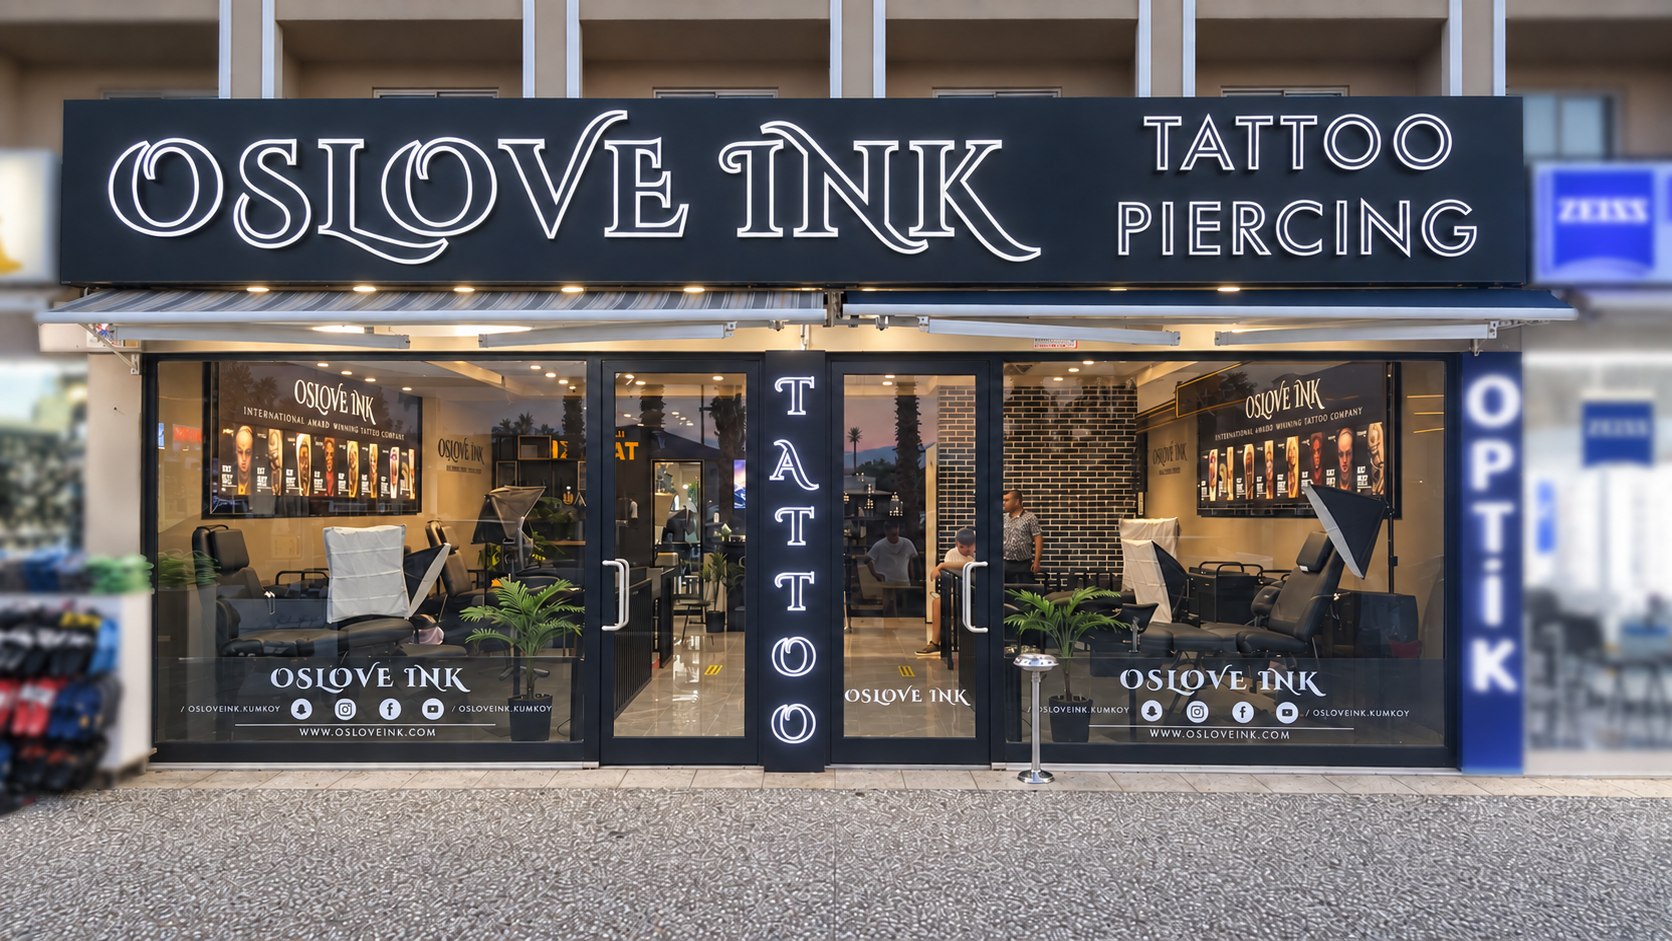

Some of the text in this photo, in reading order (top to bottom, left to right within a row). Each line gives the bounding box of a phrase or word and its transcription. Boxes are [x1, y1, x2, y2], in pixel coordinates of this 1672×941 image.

[1143, 112, 1454, 172] TATTOO
[108, 109, 1042, 265] OSLOVE INK
[1117, 199, 1478, 259] PIERCING
[294, 379, 377, 426] OSLOVE INK
[1245, 377, 1326, 420] OSLOVE INK
[243, 406, 305, 425] INTERNATIONAL
[1304, 414, 1329, 425] TATTOO
[1330, 406, 1364, 421] COMPANY
[438, 437, 485, 465] OSLOVE INK
[769, 375, 820, 745] TATTOO
[270, 661, 471, 694] OSLOVE INK
[1120, 664, 1327, 697] OSLOVE INK
[187, 705, 281, 713] OSLOVEINK.KUMKOY
[458, 705, 553, 713] OSLOVEINK.KUMKOY
[844, 684, 971, 707] OSLOVE INK
[1312, 709, 1410, 717] OSLOVEINK.KUMKOY
[299, 728, 437, 737] WWW.OSLOVEINK.COM
[1149, 729, 1290, 740] WWW.OSLOVEINK.COM
